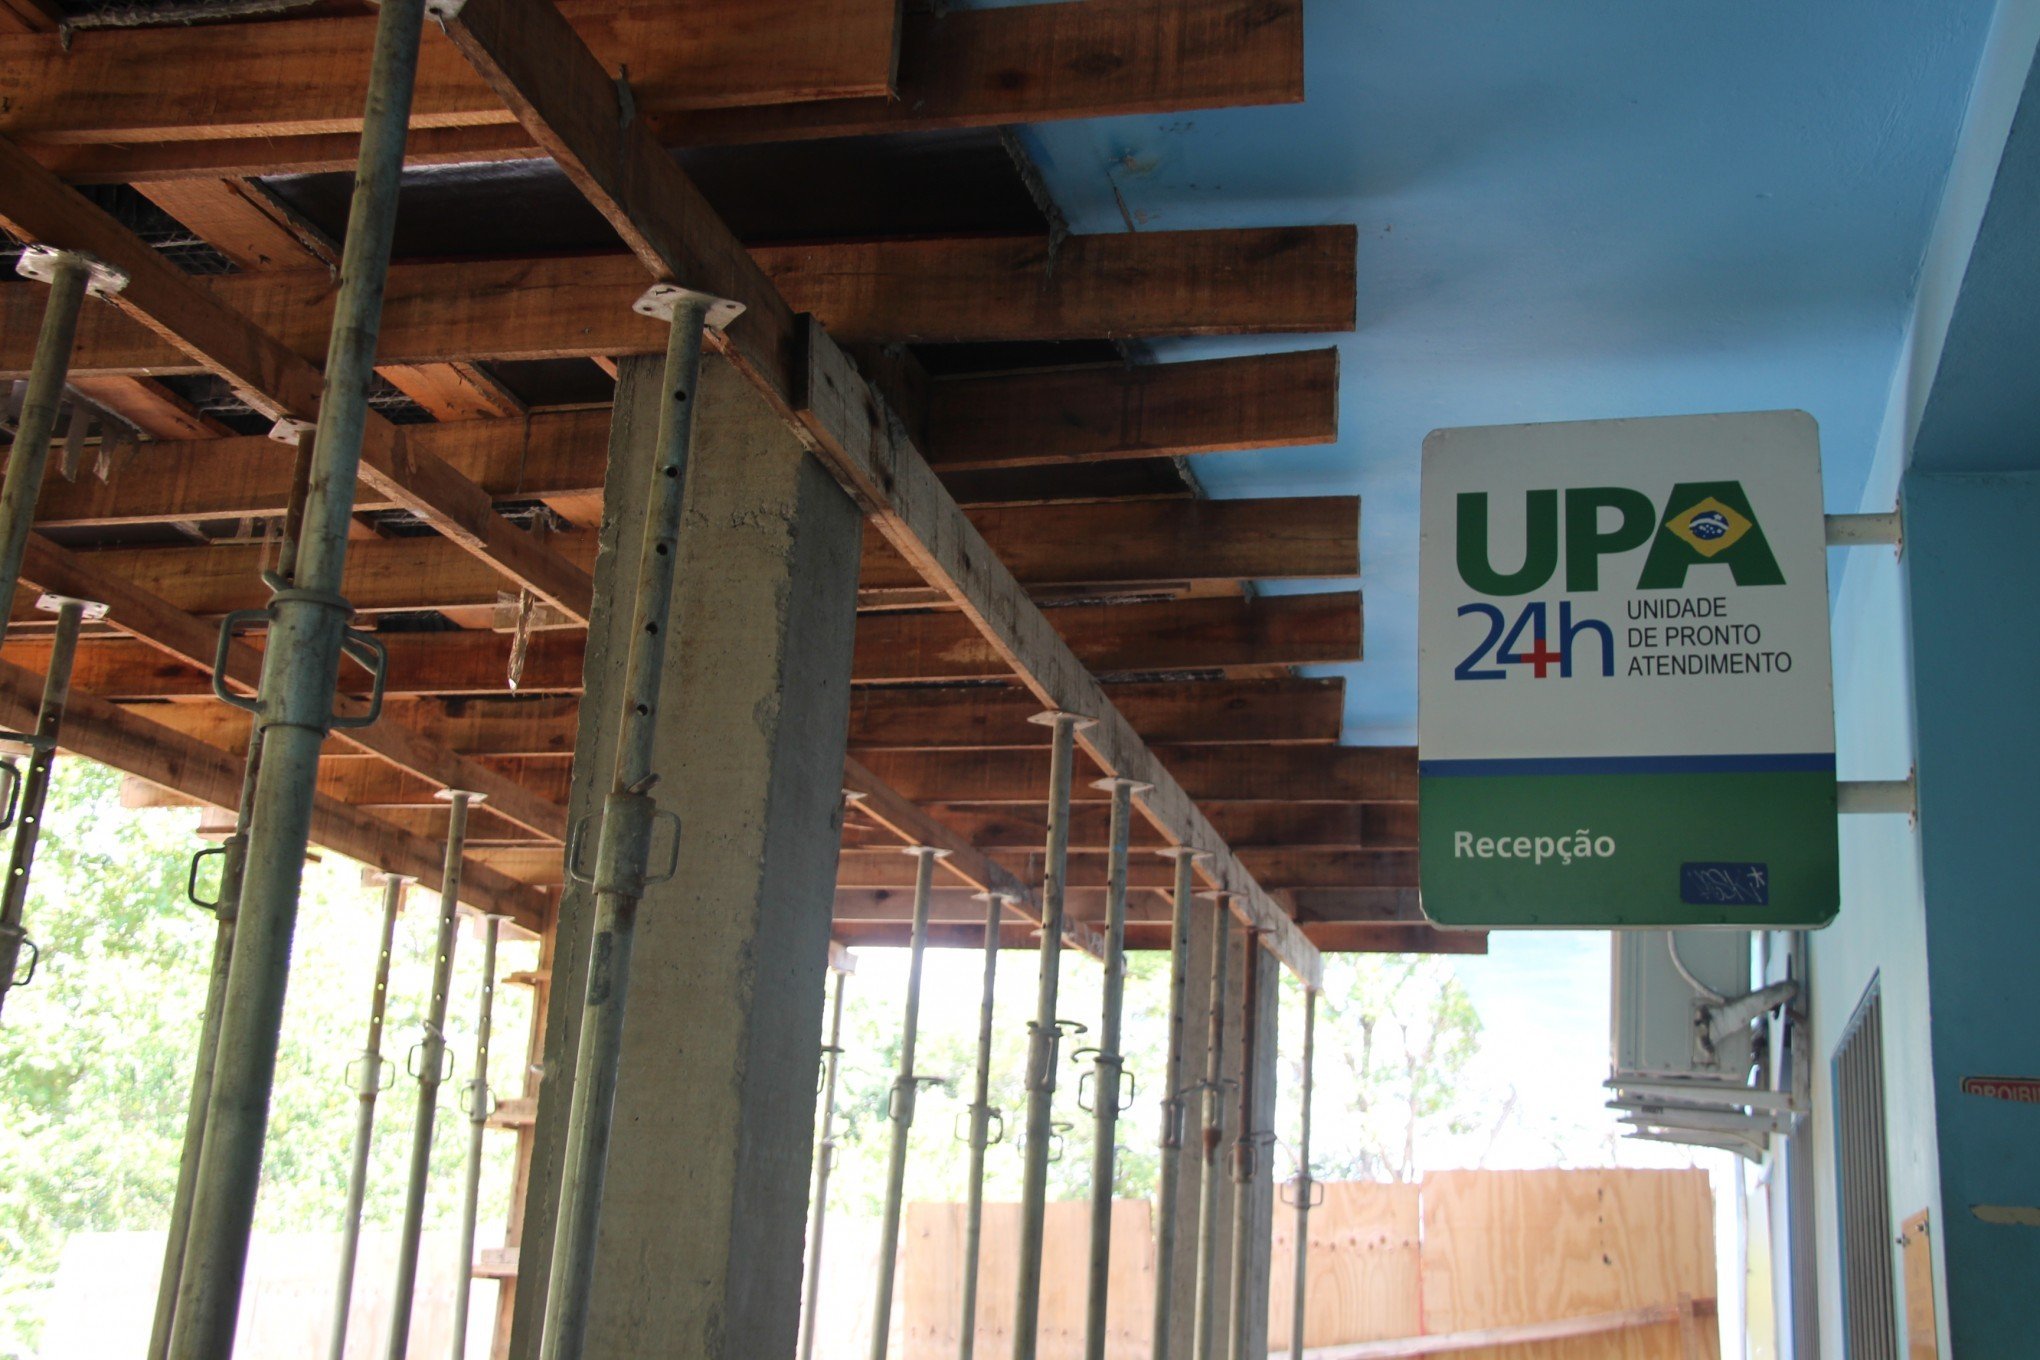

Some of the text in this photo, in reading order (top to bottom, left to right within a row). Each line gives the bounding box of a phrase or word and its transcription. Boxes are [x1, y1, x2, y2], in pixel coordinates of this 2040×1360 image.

[1456, 480, 1787, 597] UPA
[1627, 597, 1728, 620] UNIDADE
[1454, 601, 1615, 680] 24h
[1627, 623, 1762, 648] DE PRONTO
[1627, 651, 1793, 677] ATENDIMENTO
[1454, 829, 1616, 865] Recepção
[1971, 1085, 2040, 1103] PROIBI
